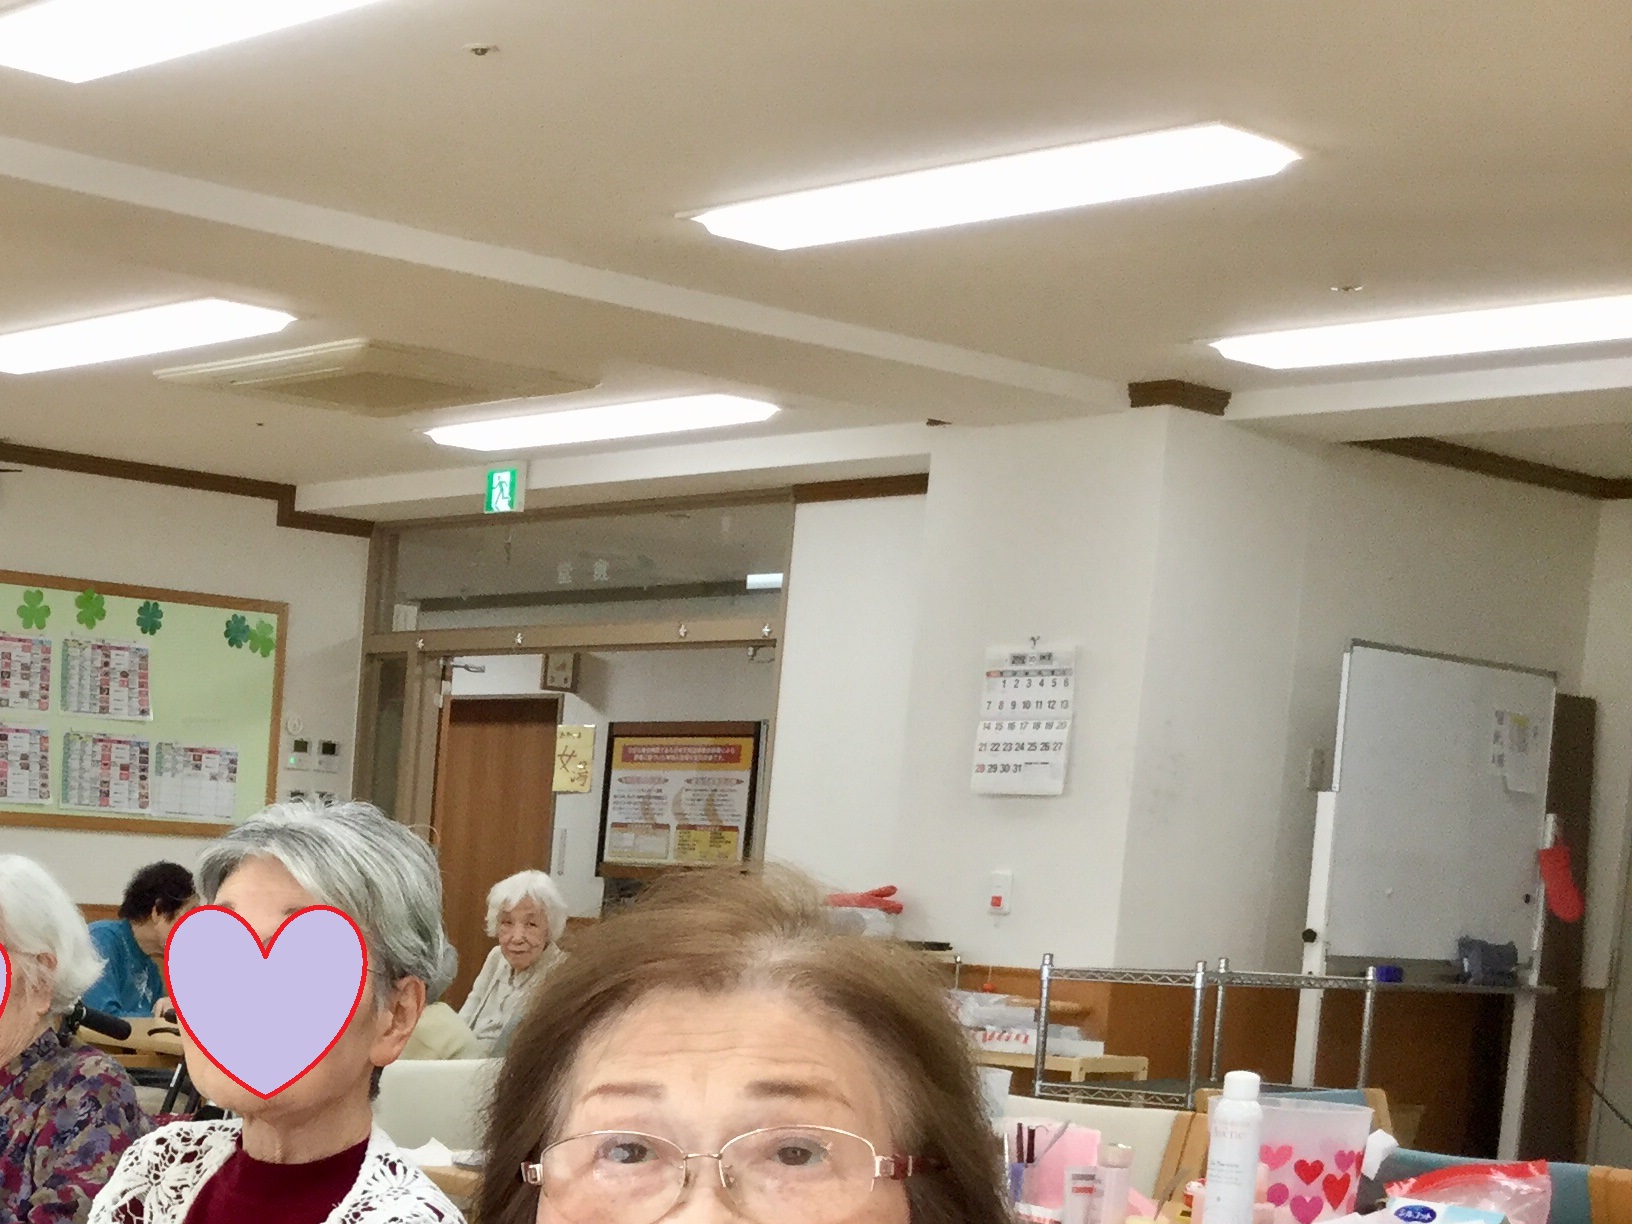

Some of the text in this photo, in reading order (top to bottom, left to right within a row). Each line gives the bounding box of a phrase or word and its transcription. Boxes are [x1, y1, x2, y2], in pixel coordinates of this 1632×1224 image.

[1002, 677, 1069, 688] 1 2 3 4 5 6
[986, 699, 1068, 710] 7 8 9 10 11 12 13
[978, 741, 1063, 751] 21 22 23 24 25 26 27
[975, 763, 1022, 773] 28 29 30 31
